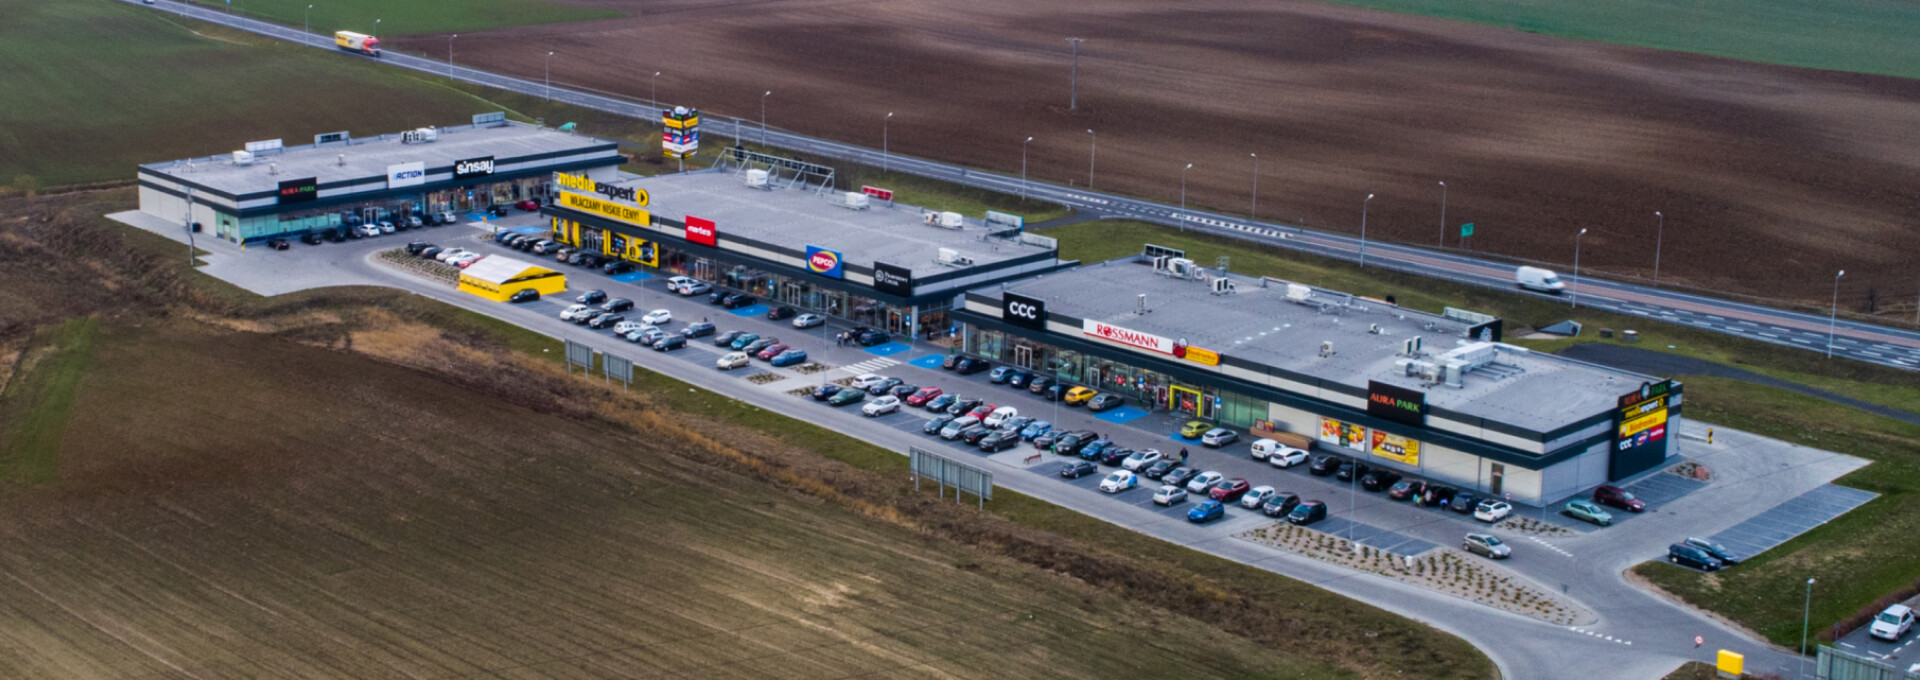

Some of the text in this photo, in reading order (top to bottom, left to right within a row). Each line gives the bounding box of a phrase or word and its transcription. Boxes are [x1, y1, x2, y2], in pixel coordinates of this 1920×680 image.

[396, 170, 422, 180] ACTION
[457, 160, 494, 175] sinsay
[812, 255, 834, 267] PEPCO
[1009, 301, 1037, 320] CCC
[1096, 323, 1159, 349] ROSSMANN
[1370, 393, 1420, 413] AURA PARK
